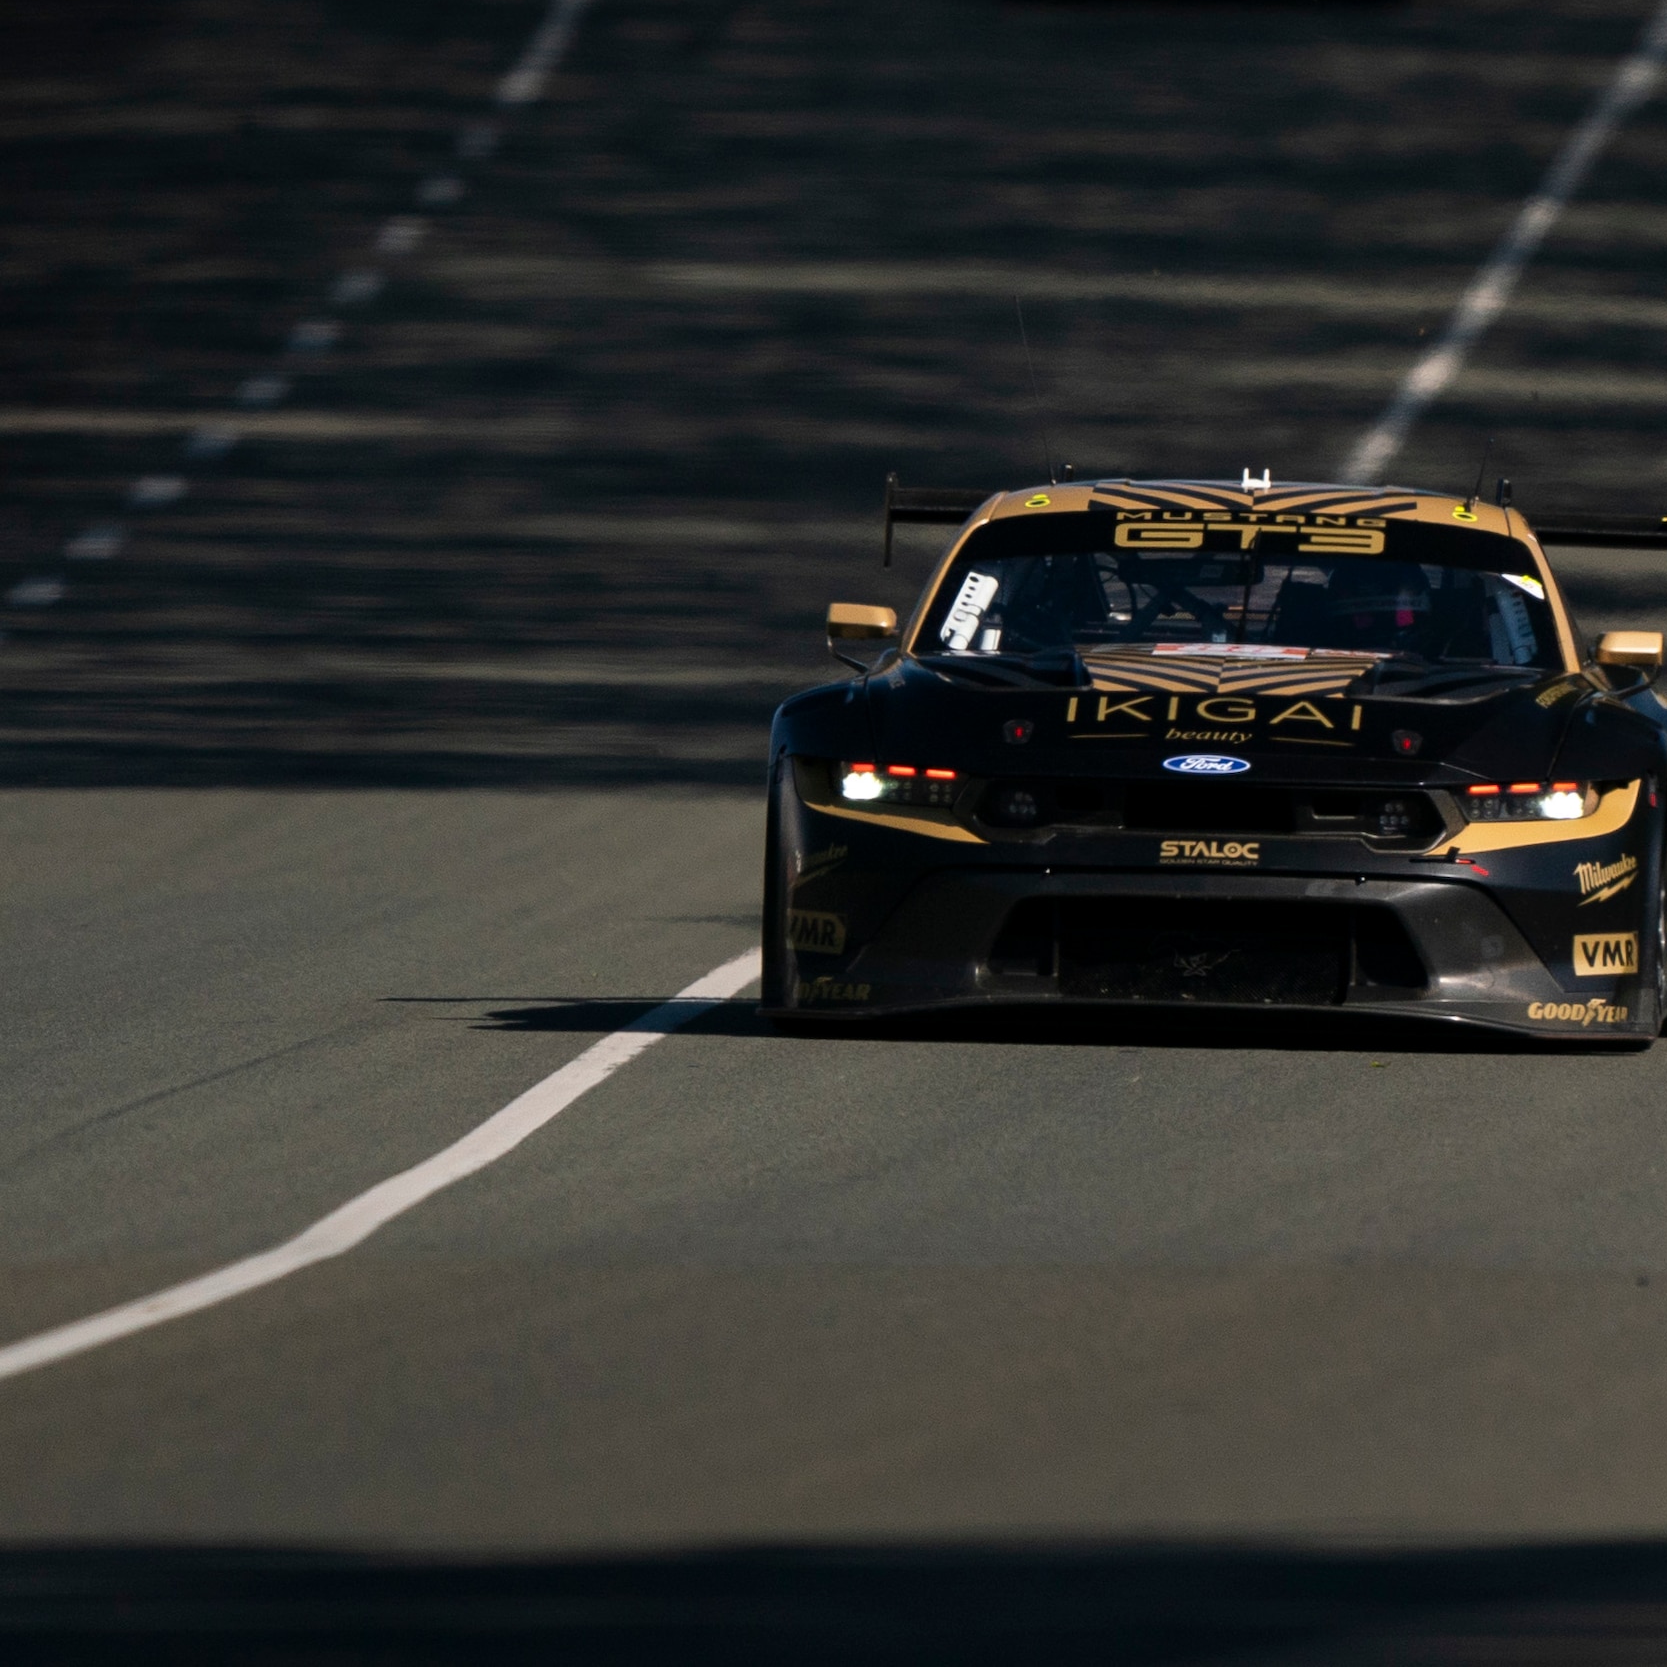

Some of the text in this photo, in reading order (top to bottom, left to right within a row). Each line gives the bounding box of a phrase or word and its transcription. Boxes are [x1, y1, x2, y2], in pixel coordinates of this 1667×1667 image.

[1115, 511, 1387, 528] MUSTANG
[1114, 522, 1386, 555] GT3
[1066, 695, 1362, 731] IKIGAI
[1164, 727, 1253, 744] beauty
[1178, 755, 1235, 772] Ford
[1159, 840, 1260, 860] STALOC
[1573, 852, 1638, 895] Milwaukee
[1580, 938, 1635, 969] VMR
